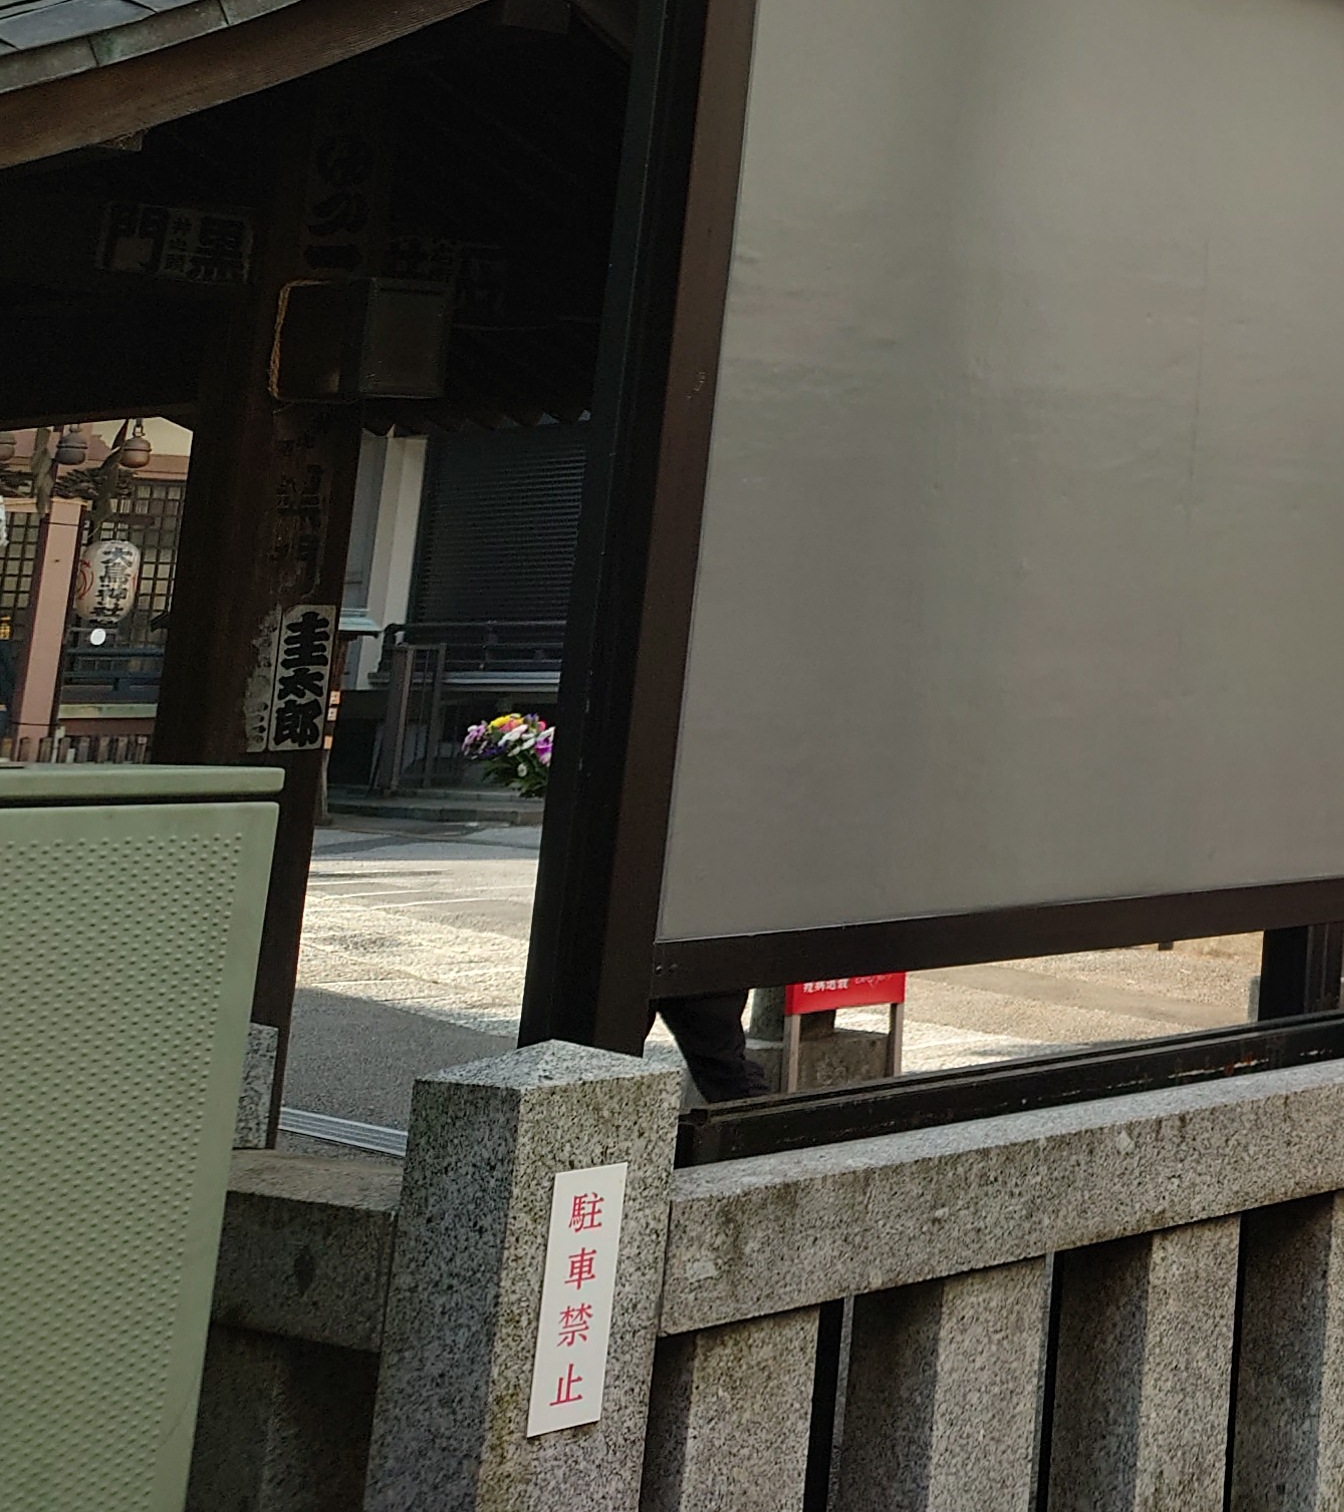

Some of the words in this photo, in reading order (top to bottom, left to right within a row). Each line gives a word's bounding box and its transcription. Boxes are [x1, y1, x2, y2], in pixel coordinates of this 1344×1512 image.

[273, 610, 331, 748] 圭太郎
[549, 1191, 605, 1408] 駐車禁止
